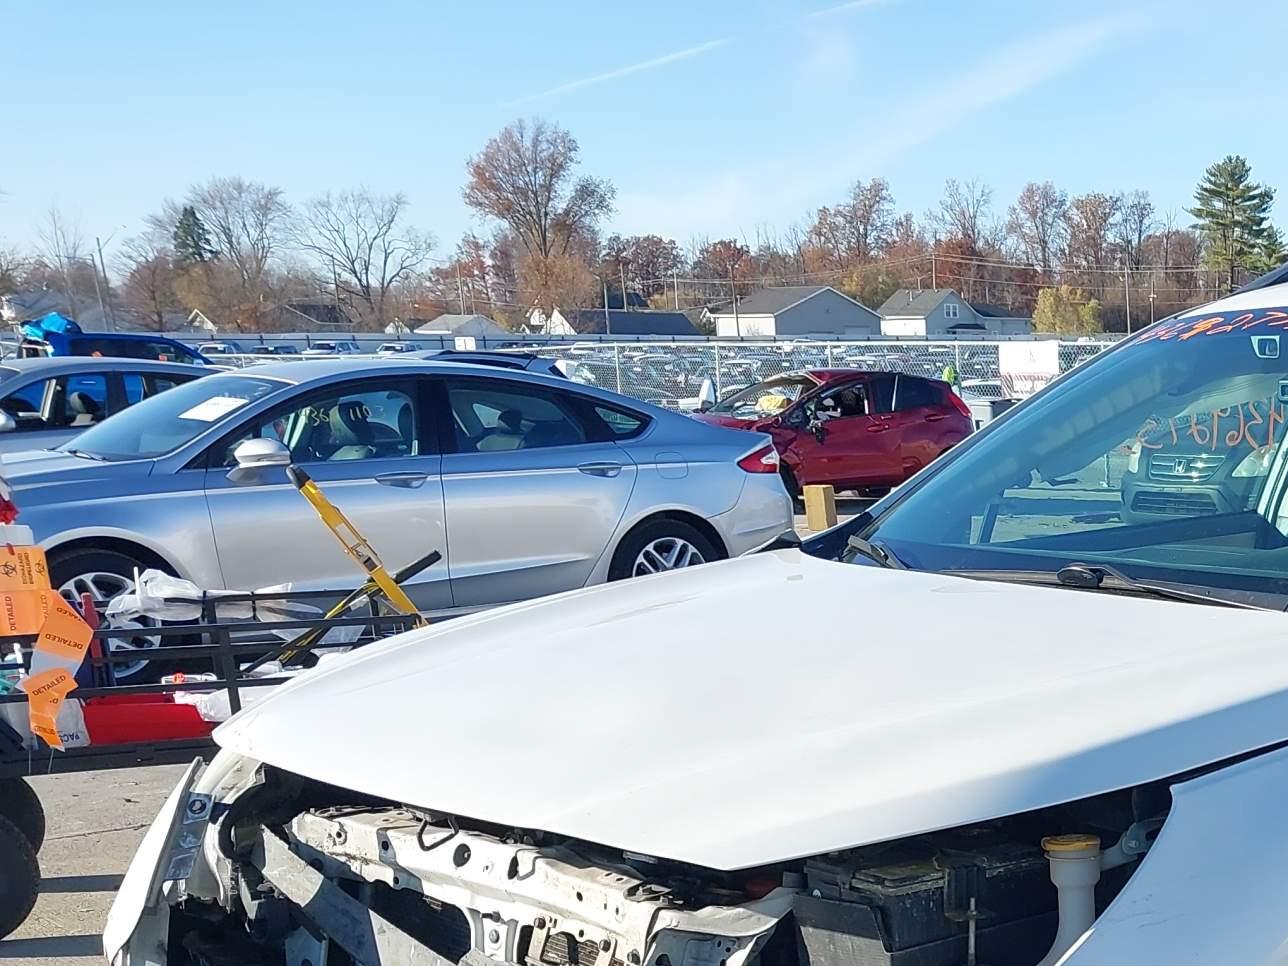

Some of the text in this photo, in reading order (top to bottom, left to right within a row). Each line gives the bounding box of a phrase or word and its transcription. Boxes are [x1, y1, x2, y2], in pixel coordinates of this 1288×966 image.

[5, 596, 17, 631] DETAILED
[45, 633, 84, 650] DETAILED
[32, 675, 67, 696] DETAILED
